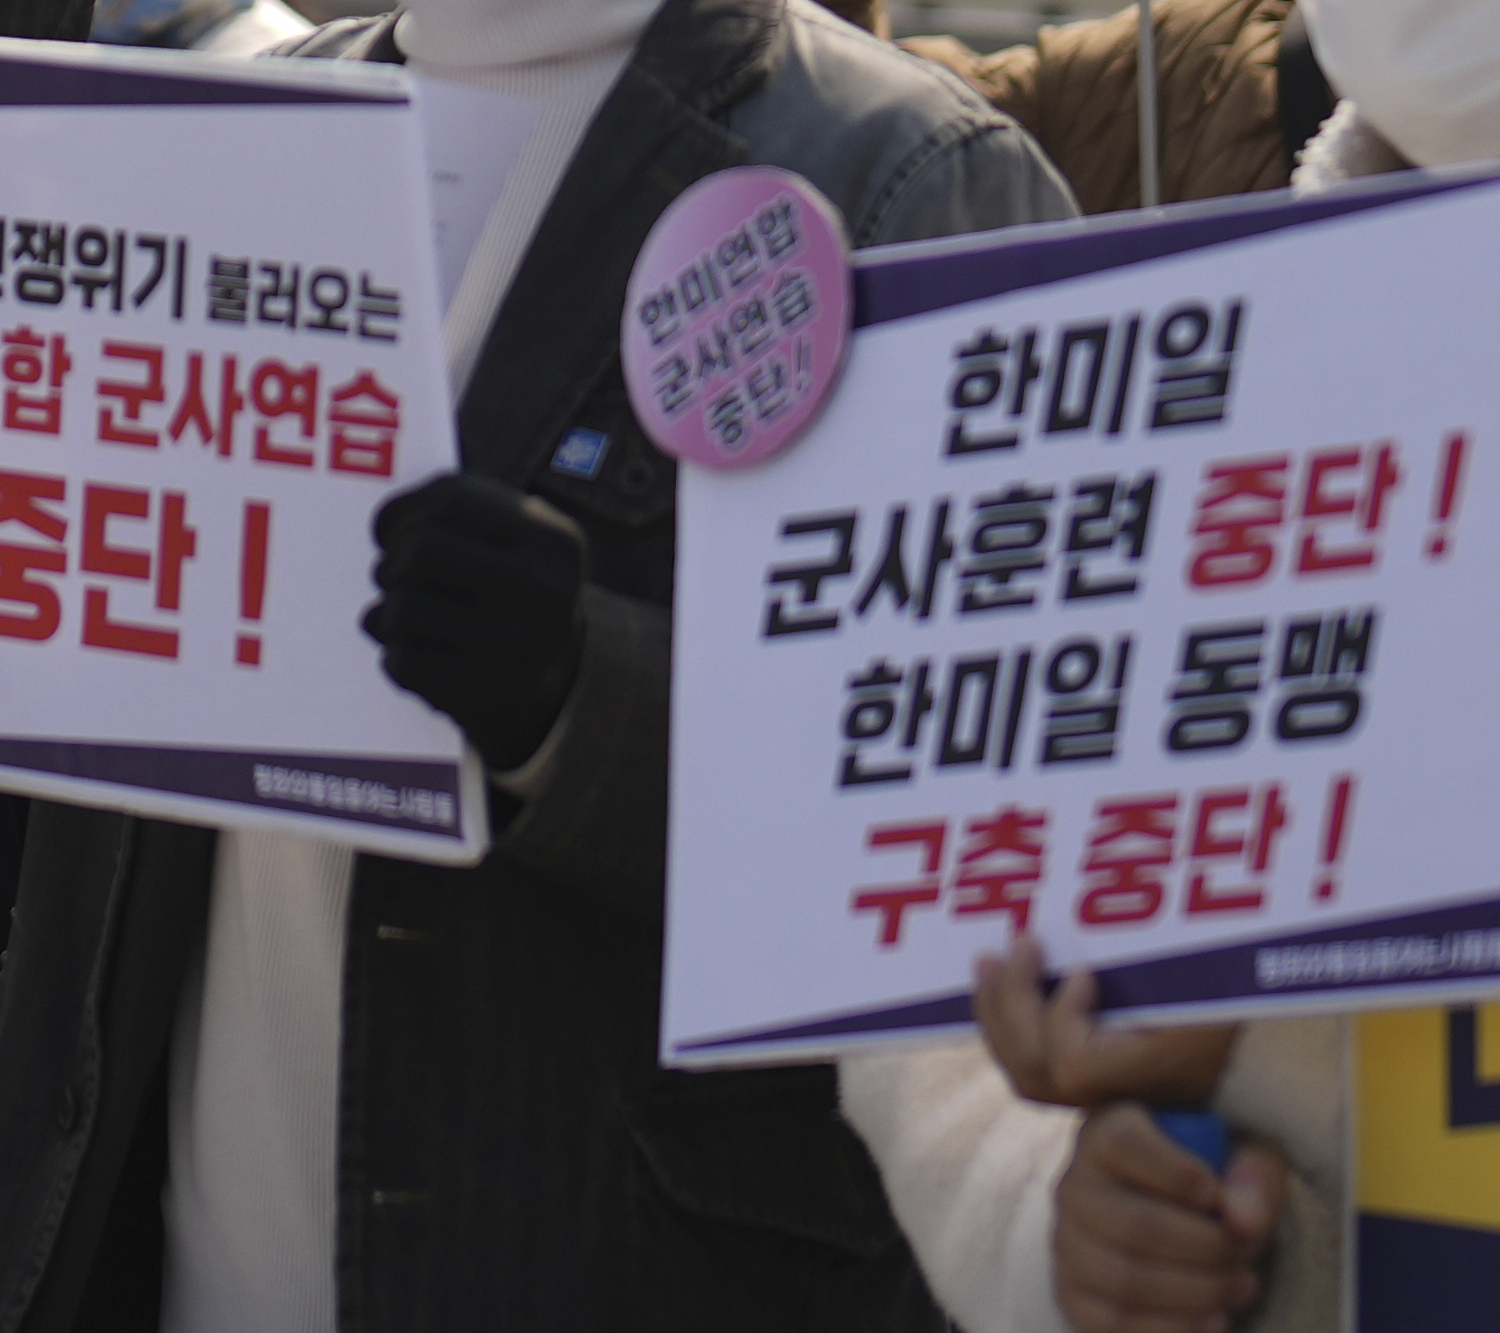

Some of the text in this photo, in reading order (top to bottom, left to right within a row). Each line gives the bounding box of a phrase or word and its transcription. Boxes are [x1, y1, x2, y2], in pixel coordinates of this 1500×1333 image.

[206, 254, 404, 344] 불러오는
[641, 197, 797, 346] 한미연합
[653, 270, 813, 413] 군사연습
[96, 338, 402, 479] 군사연습
[709, 334, 810, 445] 중단!
[943, 296, 1246, 460] 한미일
[759, 469, 1156, 643] 군사훈련
[835, 607, 1378, 792] 한미일 동맹
[849, 806, 1048, 950] 구축
